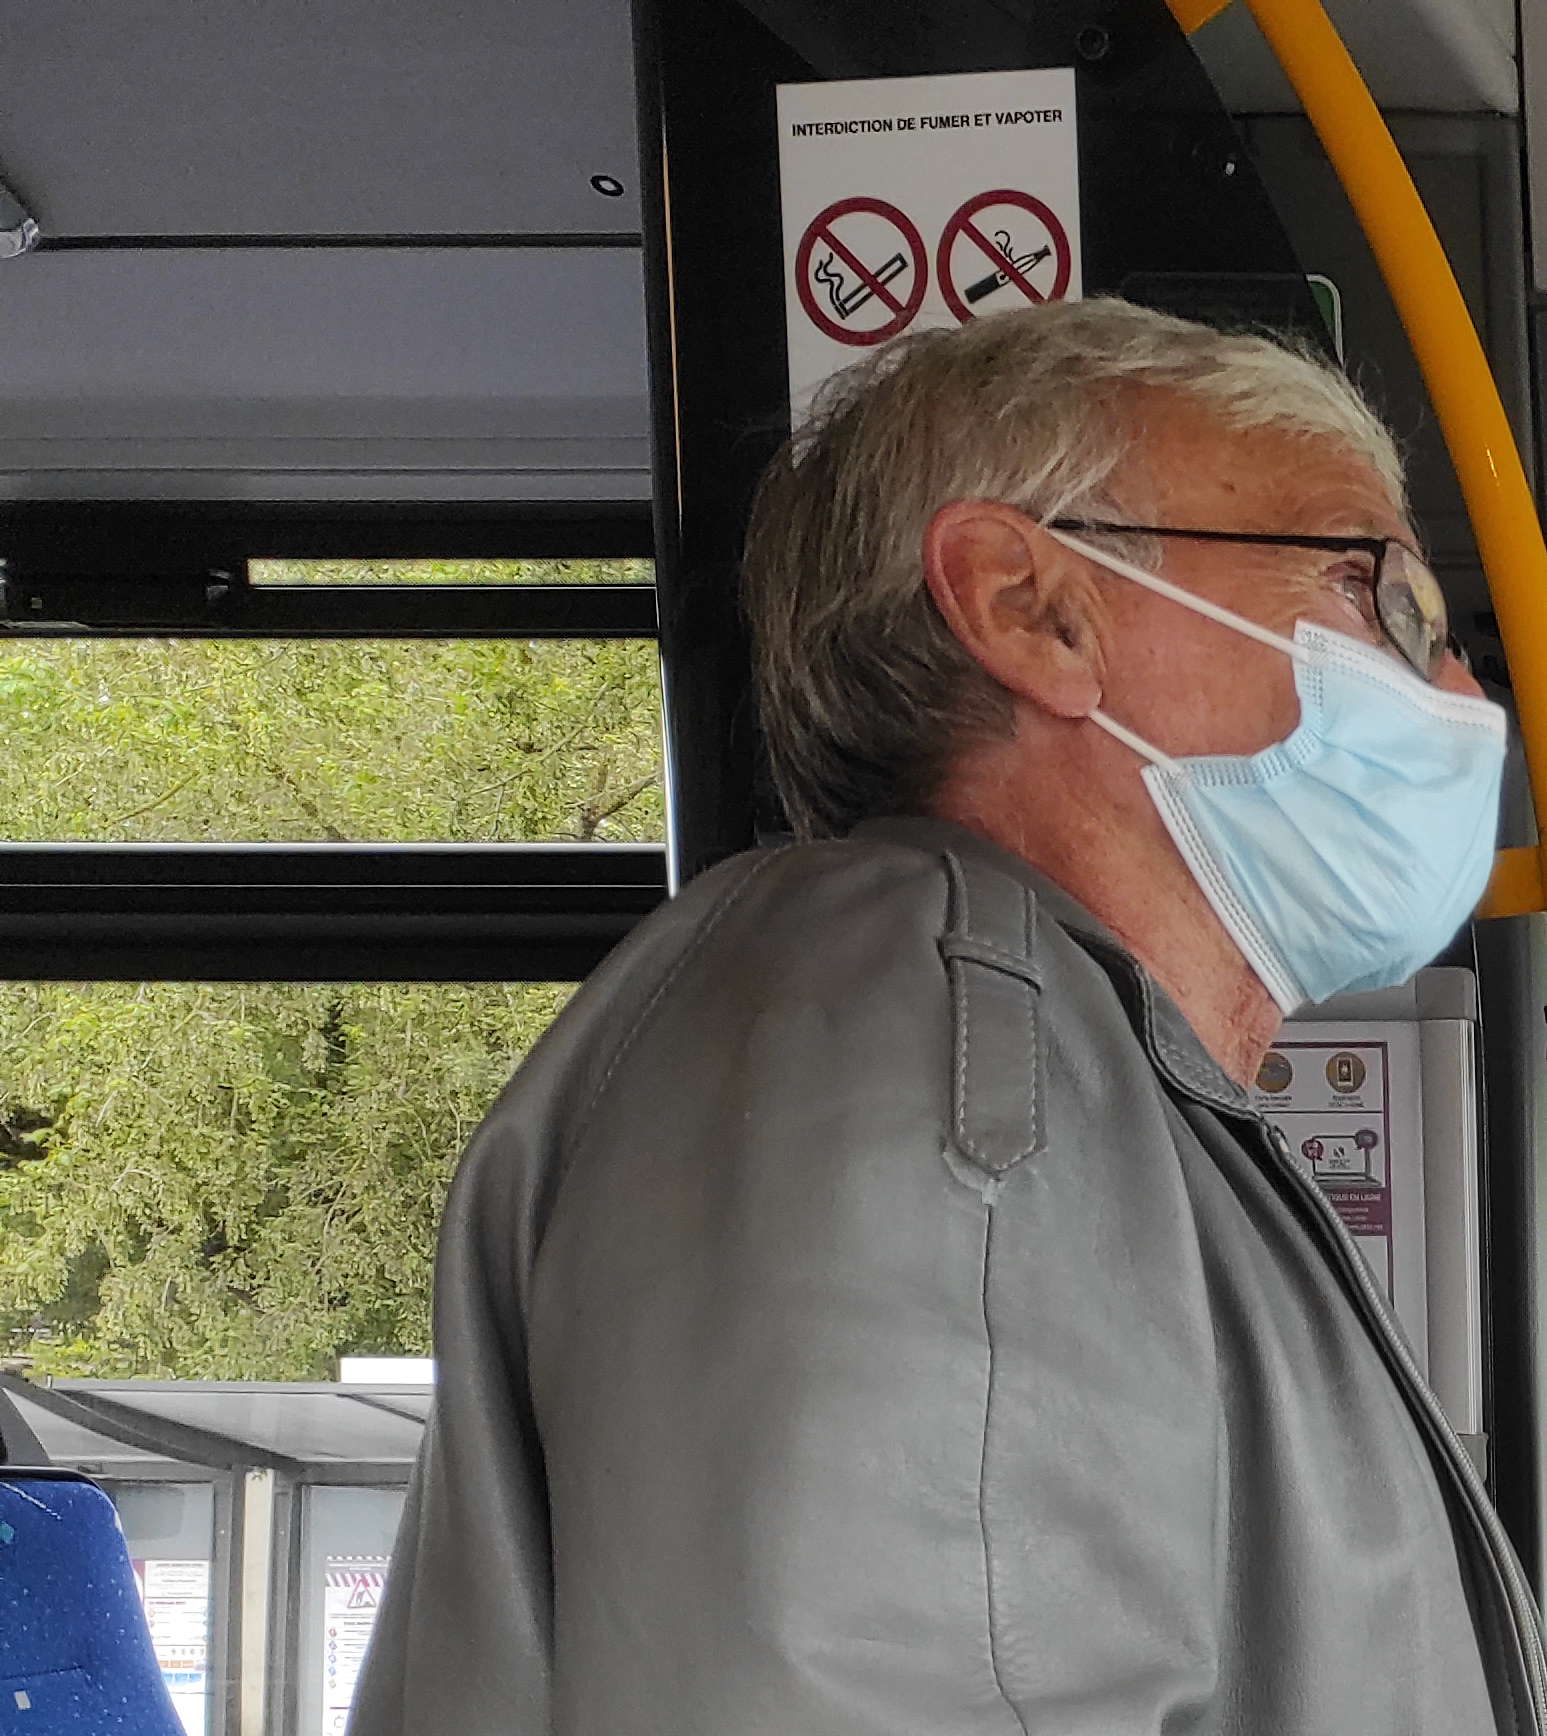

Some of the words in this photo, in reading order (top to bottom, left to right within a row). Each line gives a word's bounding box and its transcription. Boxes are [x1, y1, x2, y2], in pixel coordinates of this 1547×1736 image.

[792, 118, 893, 137] INTERDICTION
[897, 117, 916, 131] DE
[920, 114, 970, 130] FUMER
[974, 113, 992, 127] ET
[995, 109, 1063, 125] VAPOTER
